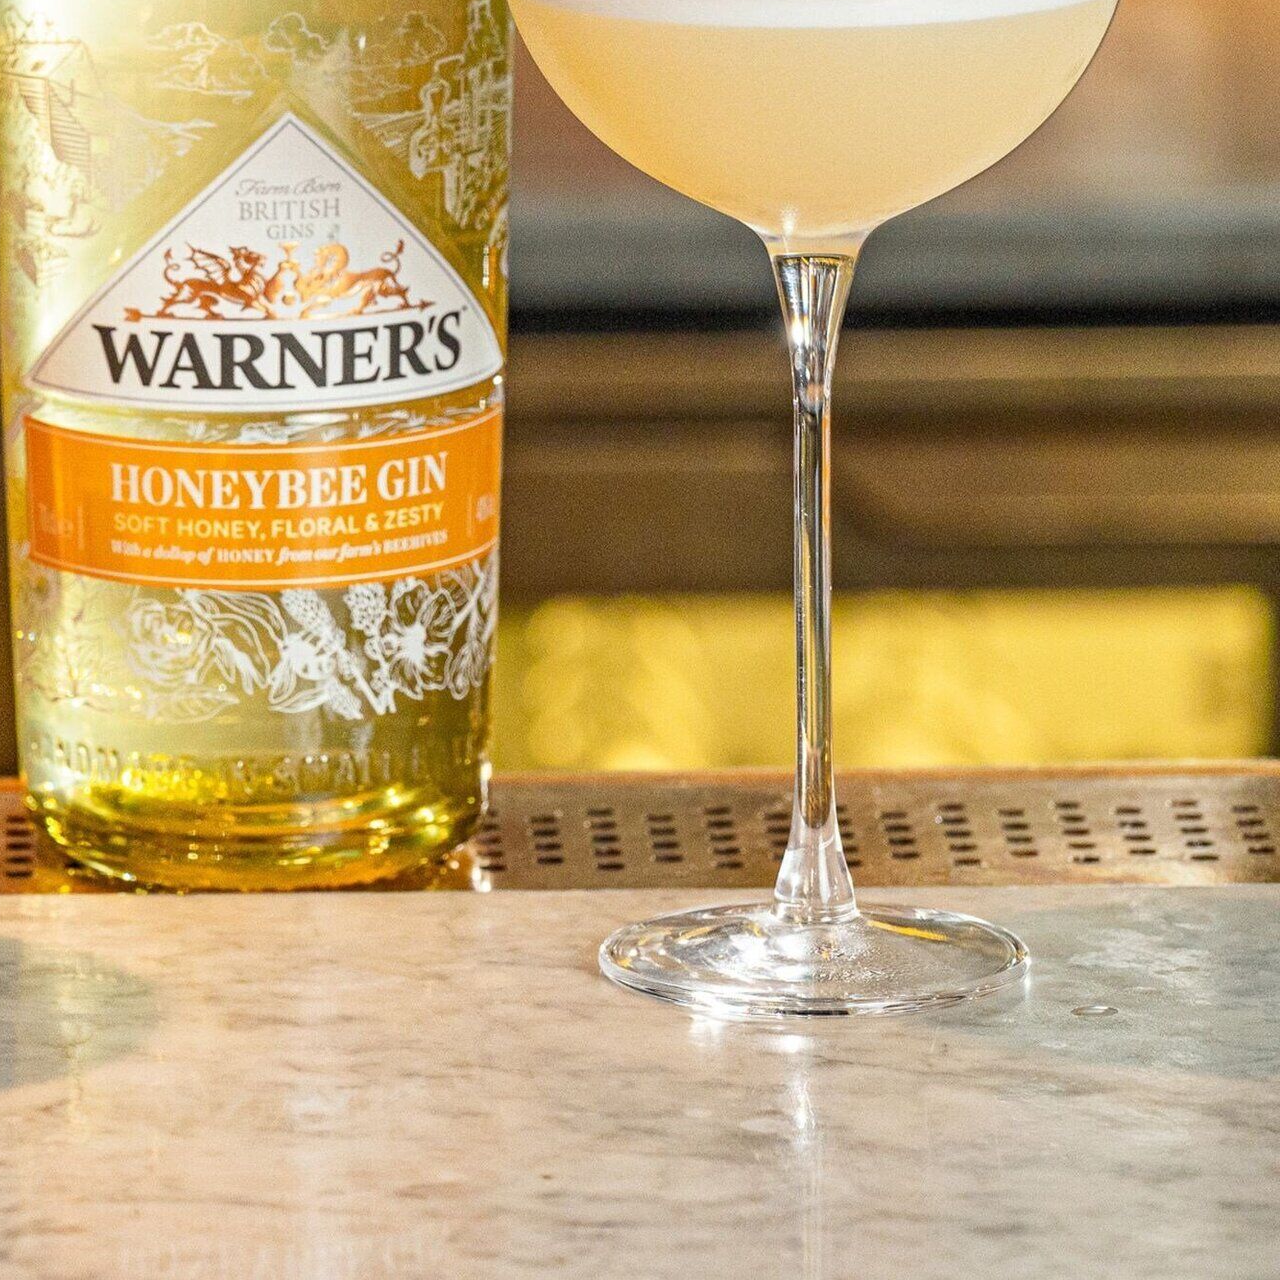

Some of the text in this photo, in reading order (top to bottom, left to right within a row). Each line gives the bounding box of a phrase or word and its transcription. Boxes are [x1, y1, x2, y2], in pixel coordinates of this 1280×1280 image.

[235, 176, 341, 197] Farm Born
[240, 197, 341, 221] BRITISH
[266, 223, 315, 240] GINS
[92, 310, 462, 392] WARNER'S
[110, 451, 448, 510] HONEYBEE GIN
[114, 500, 446, 542] SOFT HONEY, FLORAL & ZESTY
[197, 546, 215, 566] of
[216, 548, 276, 563] HONEY
[275, 545, 314, 567] from
[382, 528, 449, 555] BEEHIVES
